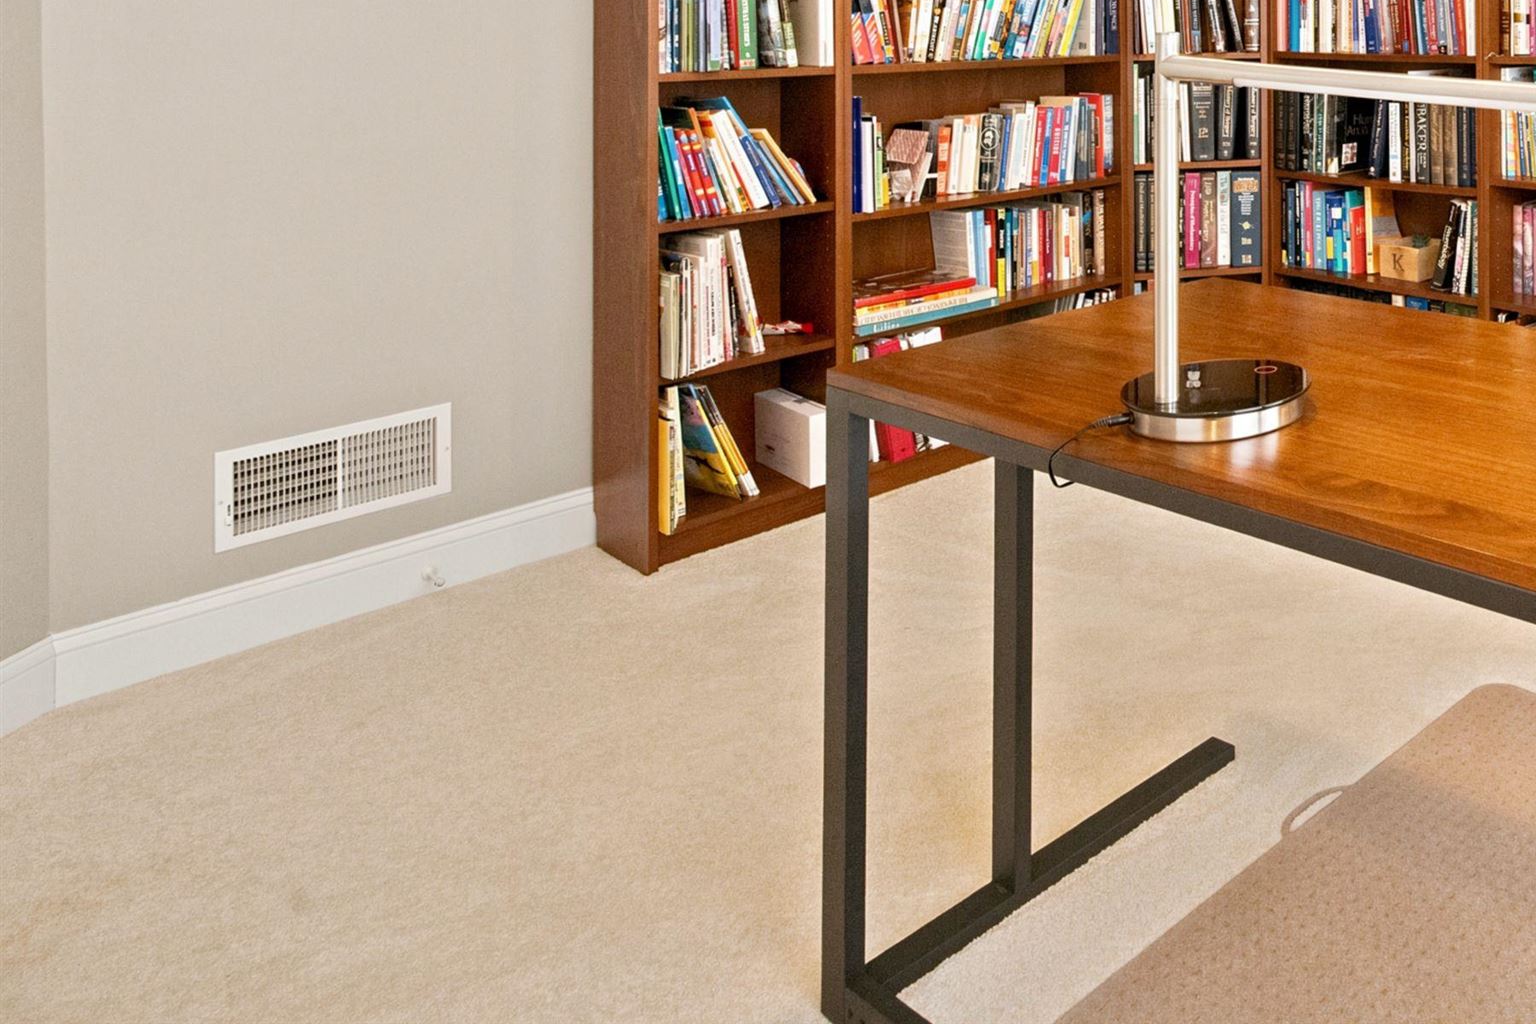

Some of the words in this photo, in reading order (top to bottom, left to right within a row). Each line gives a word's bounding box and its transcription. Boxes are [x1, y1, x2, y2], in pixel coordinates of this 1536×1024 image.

[1416, 108, 1428, 151] BAKER
[1392, 252, 1404, 273] K
[1437, 226, 1452, 270] Neurobiology
